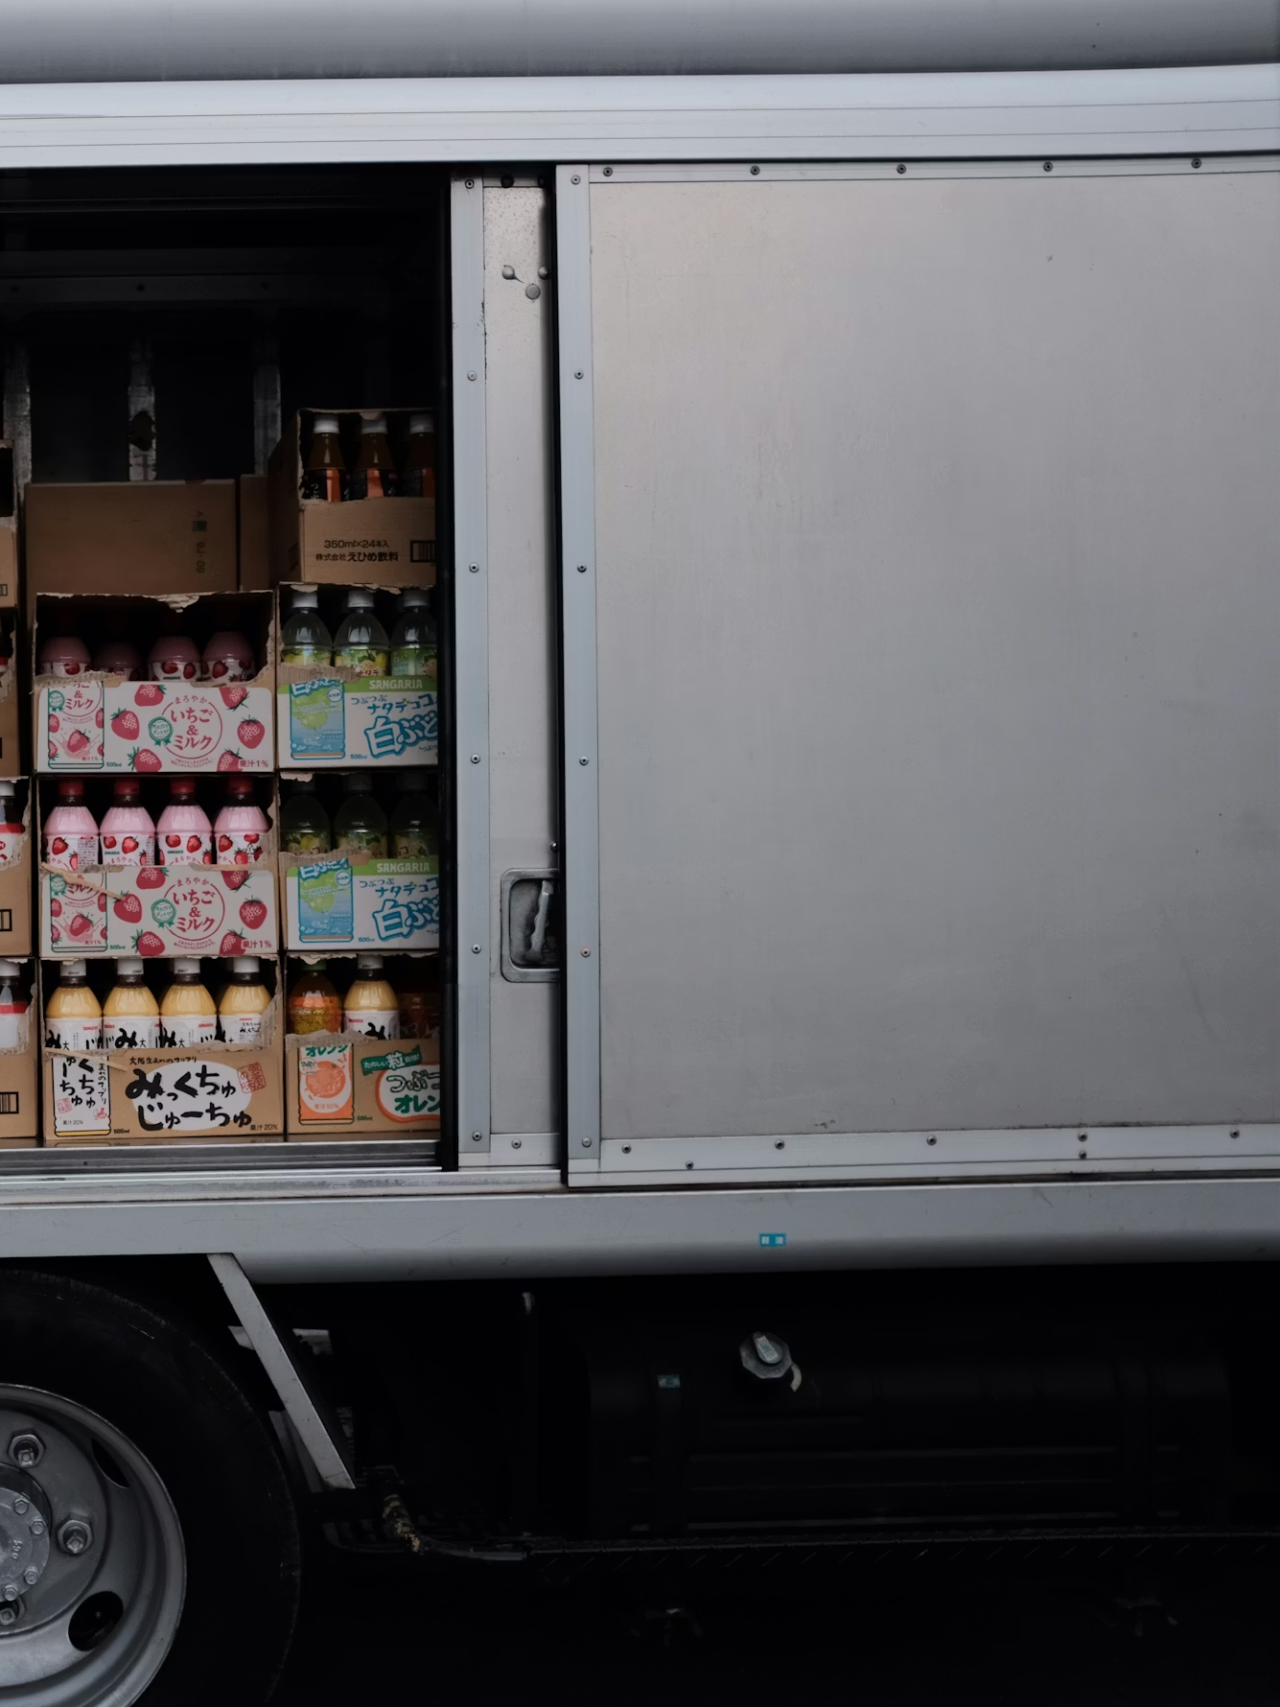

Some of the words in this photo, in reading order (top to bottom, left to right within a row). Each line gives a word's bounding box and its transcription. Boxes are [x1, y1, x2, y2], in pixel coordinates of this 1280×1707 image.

[369, 679, 423, 690] SANGARIA
[66, 698, 94, 710] ミルク
[175, 694, 207, 704] まろやか
[170, 707, 213, 723] いちご
[187, 725, 199, 736] &
[174, 735, 212, 750] ミルク
[377, 863, 430, 873] SANGARIA
[177, 877, 209, 887] まろやか
[173, 889, 215, 905] いちご
[189, 907, 201, 917] &
[176, 917, 215, 932] ミルク
[125, 1064, 236, 1101] みっくちゅ
[138, 1102, 252, 1131] じゅーちゅ
